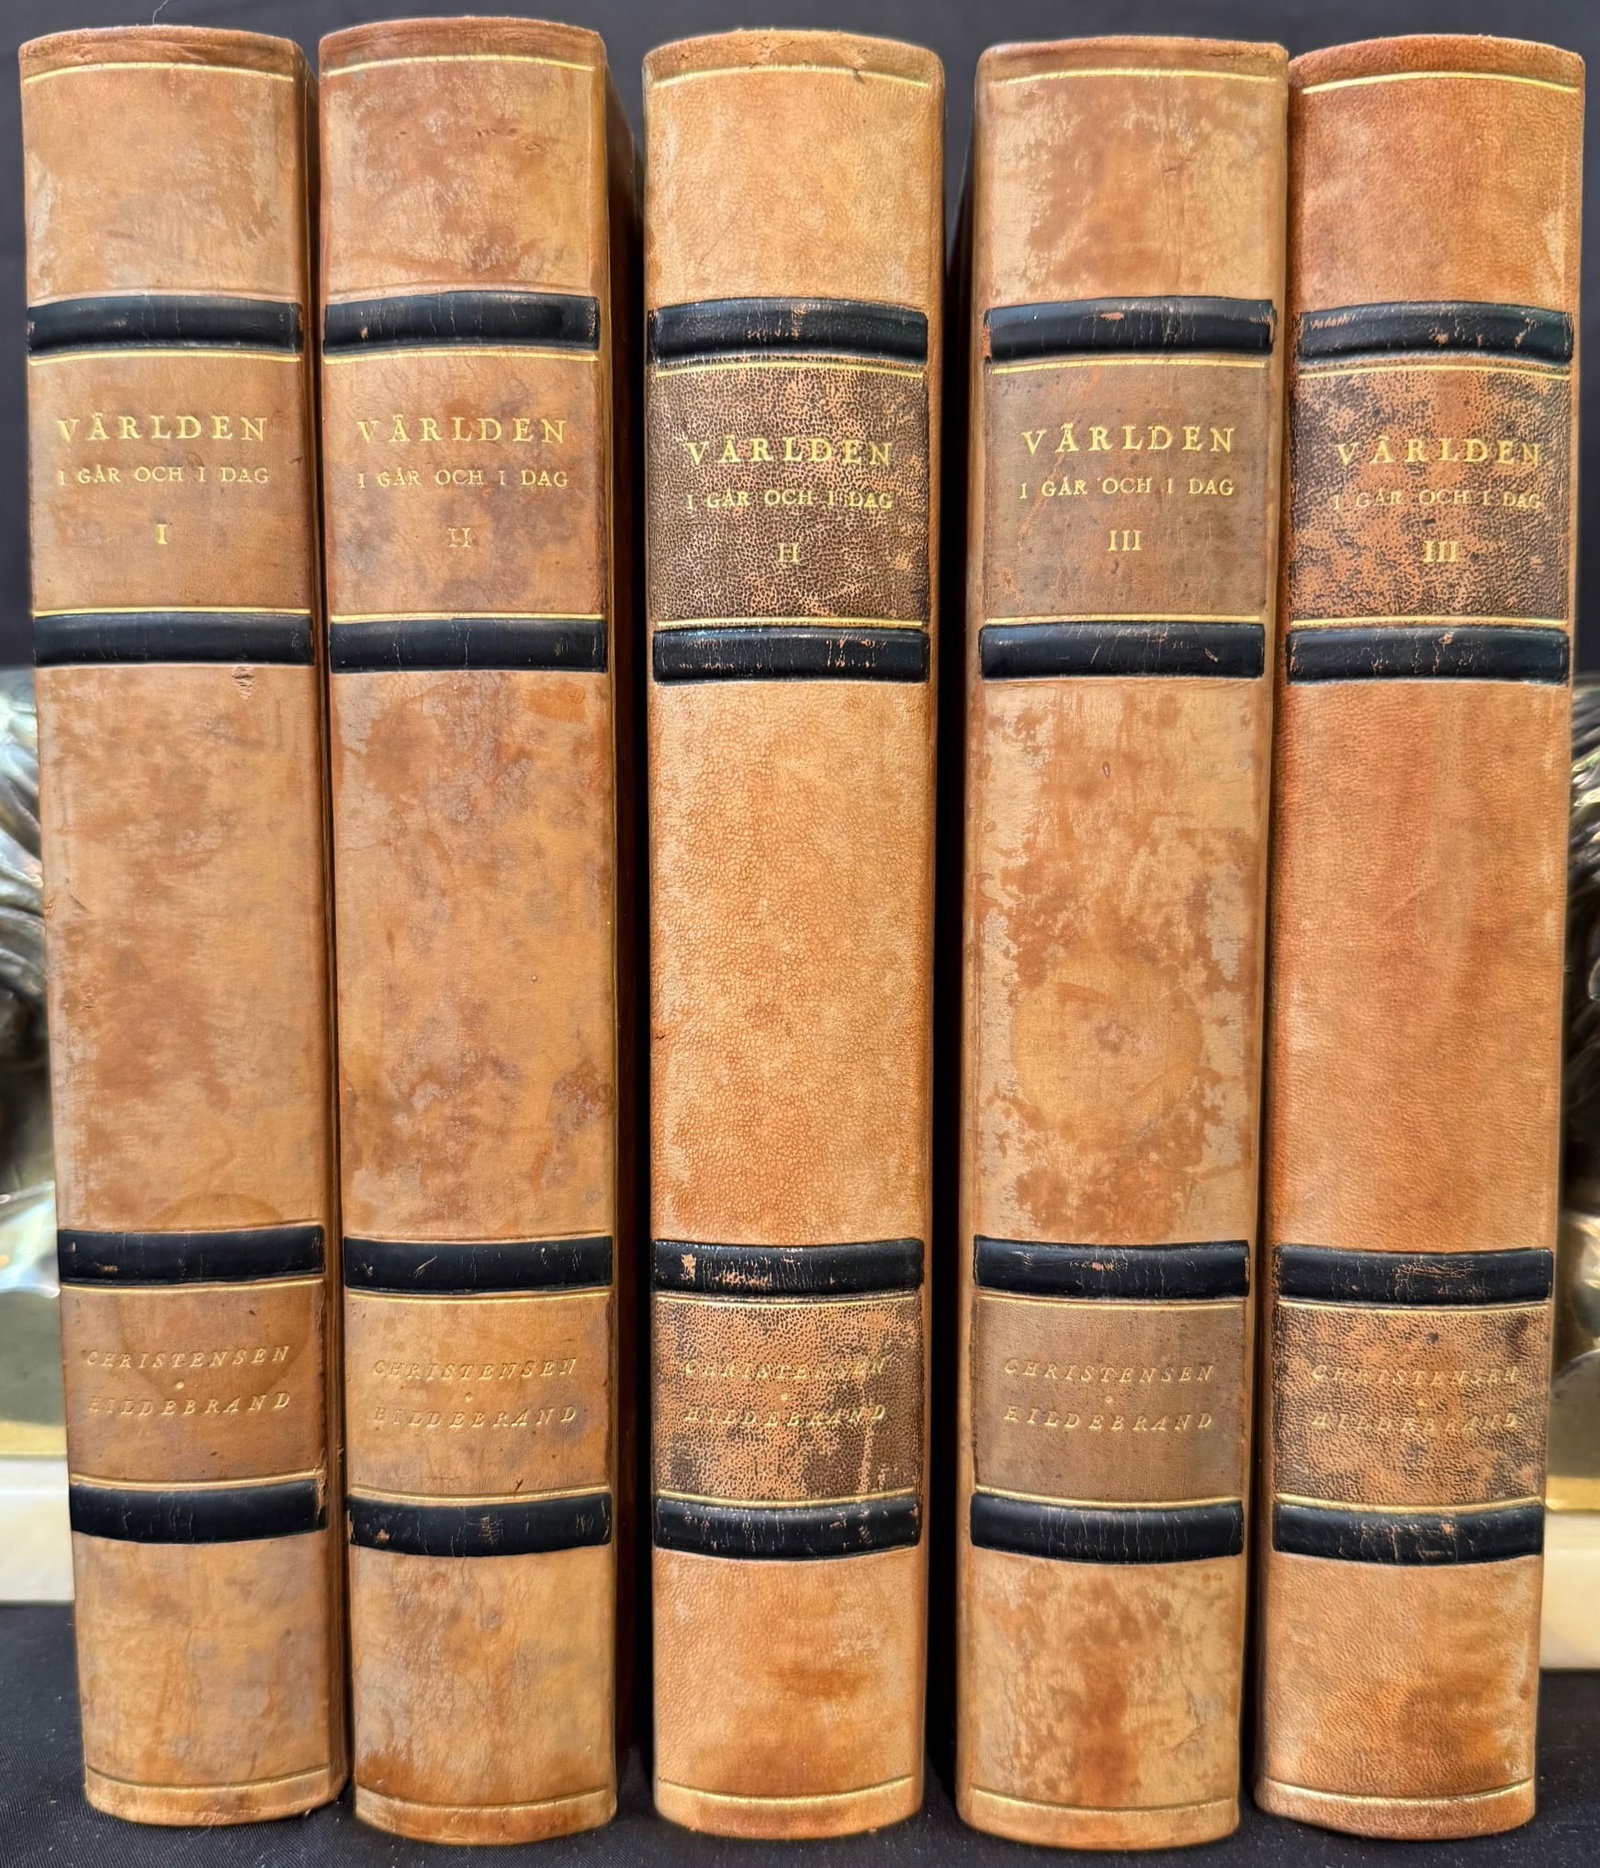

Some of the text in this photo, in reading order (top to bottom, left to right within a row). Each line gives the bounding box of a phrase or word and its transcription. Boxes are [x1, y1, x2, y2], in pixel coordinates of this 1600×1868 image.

[57, 412, 267, 442] VÄRLDEN
[357, 414, 567, 444] VÄRLDEN
[1021, 422, 1235, 455] VÄRLDEN
[687, 434, 892, 467] VÄRLDEN
[1335, 434, 1542, 466] VÄRLDEN
[58, 465, 270, 485] I GÅR OCH I DAG
[358, 467, 569, 489] I GÅR OCH I DAG
[1020, 476, 1234, 499] I GÅR OCH I DAG
[686, 488, 893, 510] I GÅR OCH I DAG
[1332, 488, 1542, 510] I GÅR OCH I DAG
[156, 523, 168, 545] I
[448, 527, 472, 548] II
[1107, 530, 1142, 551] III
[777, 542, 800, 563] II
[1422, 540, 1459, 563] III
